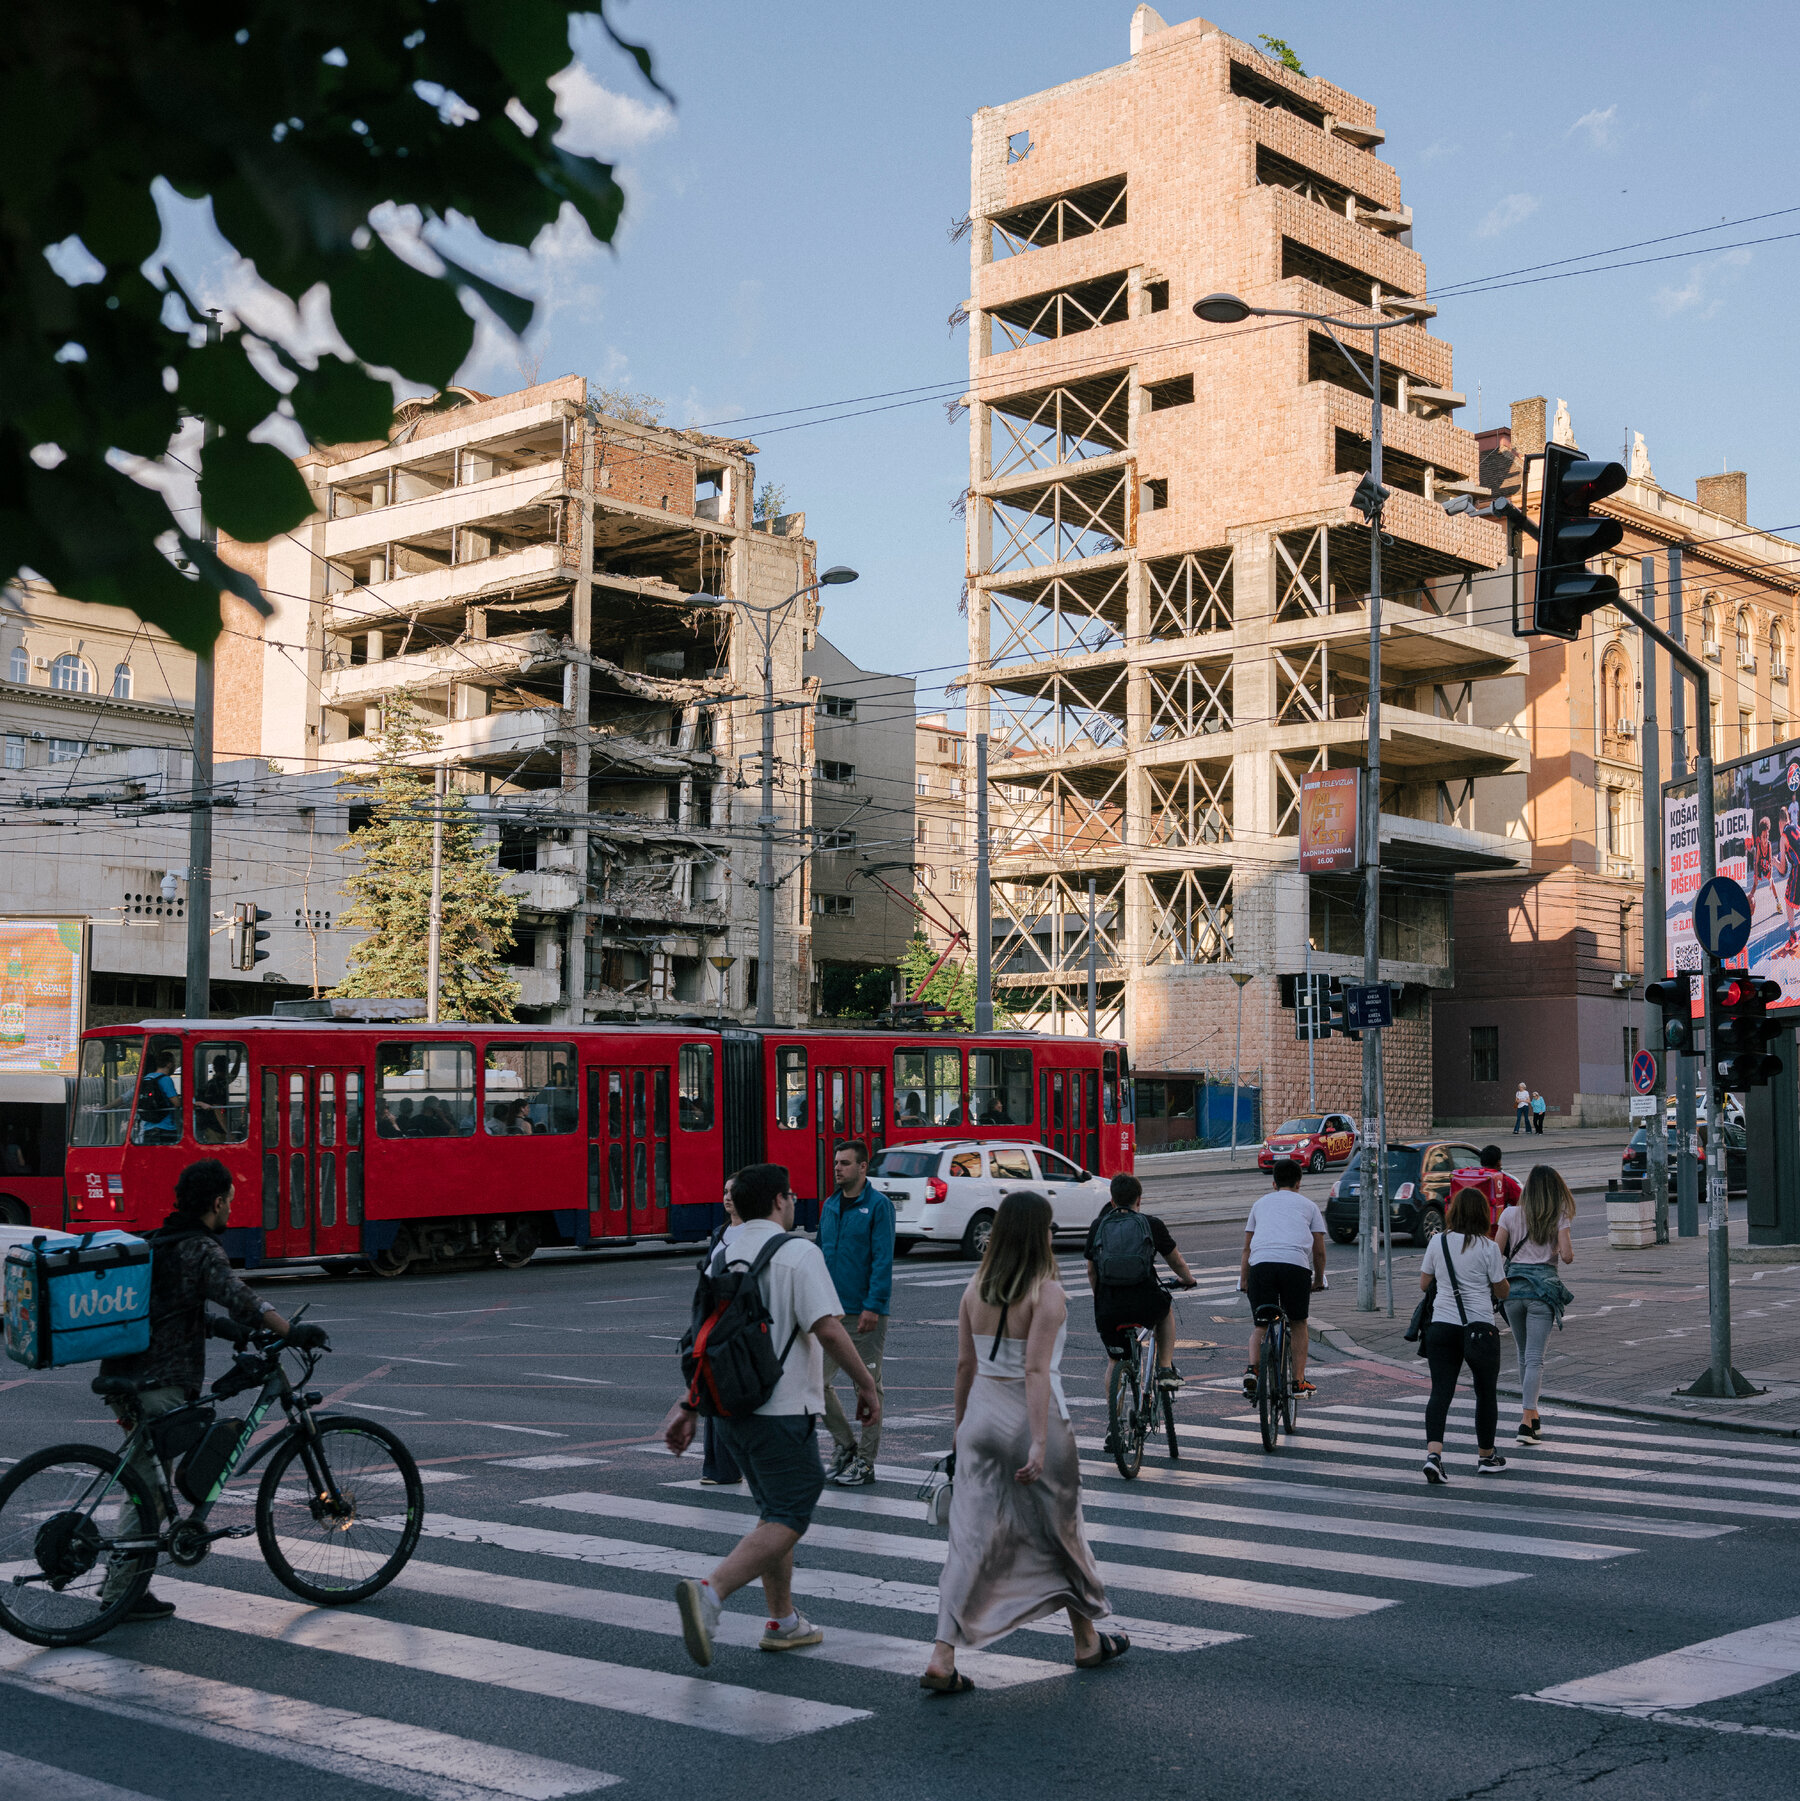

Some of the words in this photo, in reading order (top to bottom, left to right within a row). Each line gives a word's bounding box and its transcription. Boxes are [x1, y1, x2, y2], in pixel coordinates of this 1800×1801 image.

[1315, 803, 1344, 819] PET
[1670, 803, 1698, 828] KOŠAR
[1726, 813, 1750, 836] DECI,
[1302, 849, 1325, 858] RADNIM
[1326, 847, 1352, 855] DANIMA
[1317, 857, 1334, 865] 16.00
[1683, 849, 1701, 870] SEZ
[69, 1285, 138, 1319] Wolt
